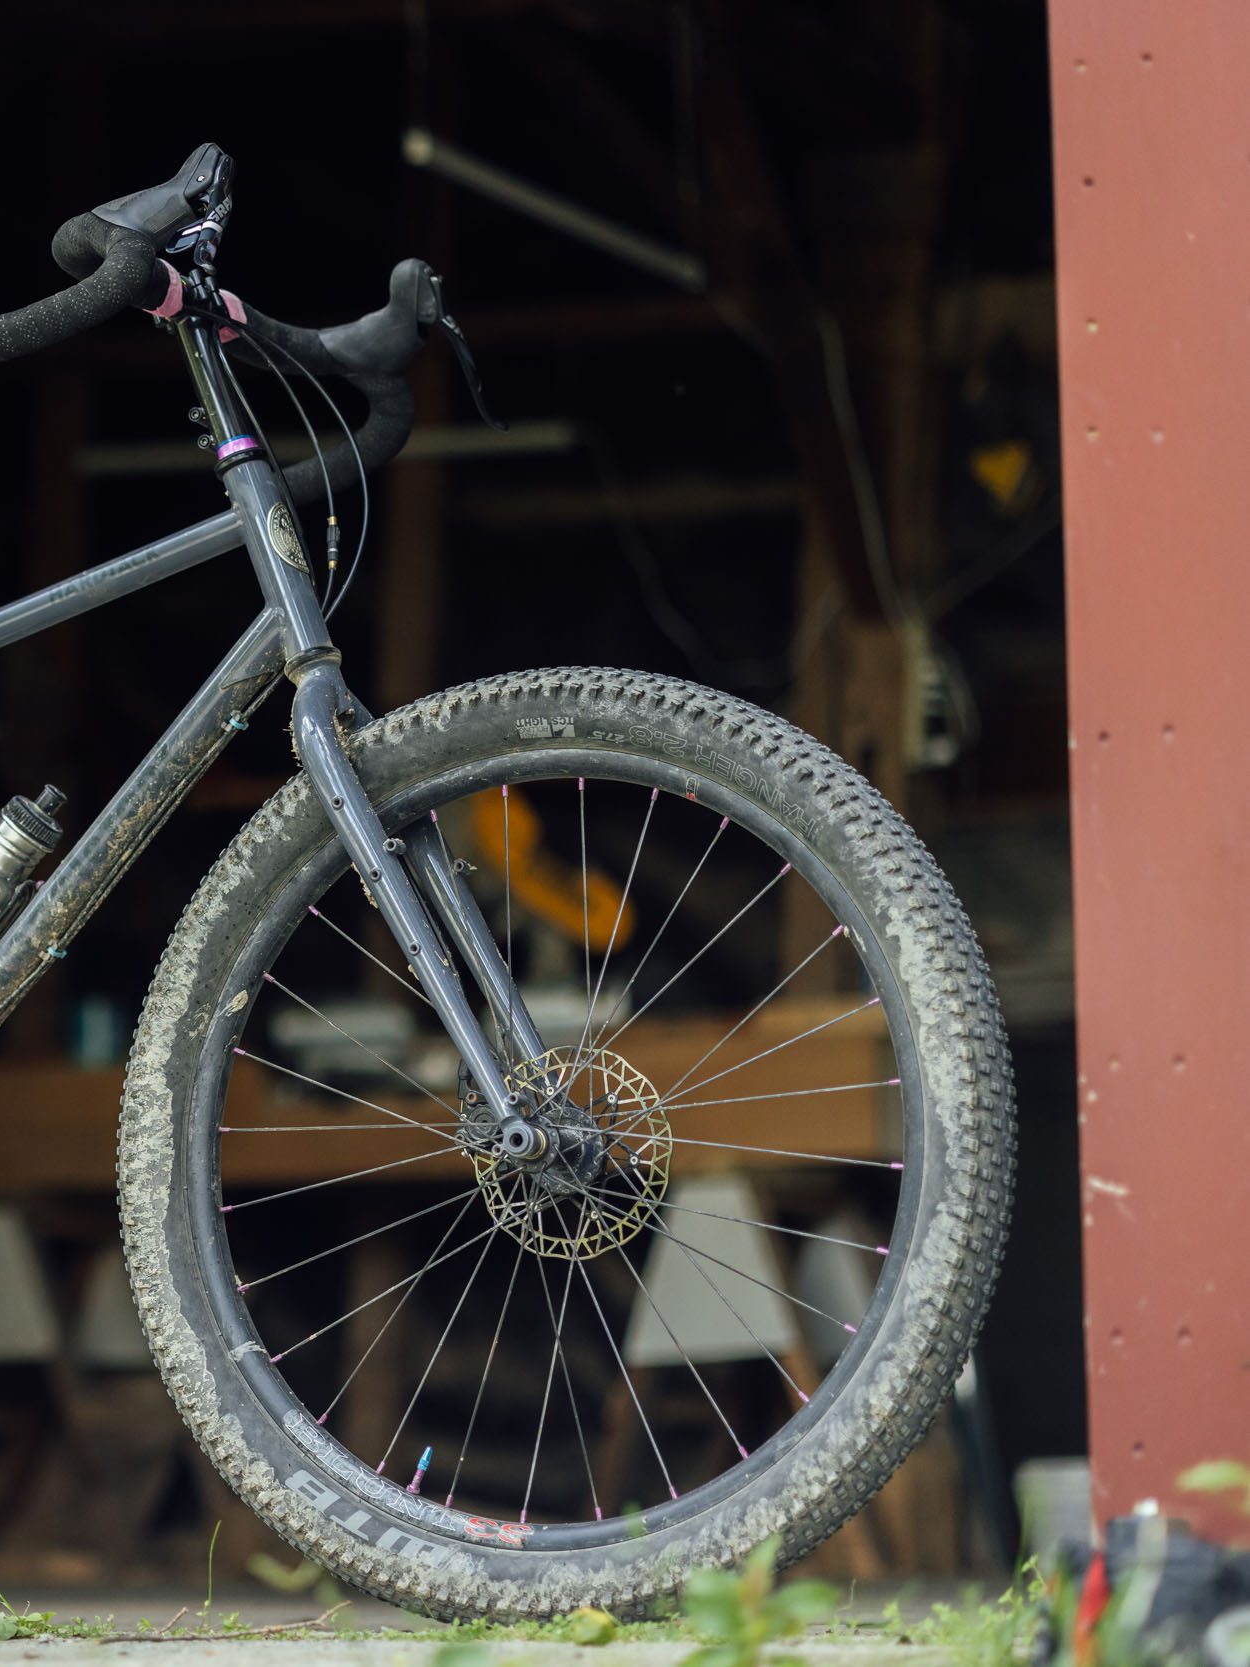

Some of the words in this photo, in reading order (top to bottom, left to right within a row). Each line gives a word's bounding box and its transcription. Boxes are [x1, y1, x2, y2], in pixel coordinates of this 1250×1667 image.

[207, 195, 233, 222] SRA
[516, 716, 551, 728] LIGHT
[551, 716, 574, 726] TCS
[629, 725, 688, 758] 2.8
[694, 744, 816, 840] RANGER
[285, 1412, 456, 1532] BLUNT
